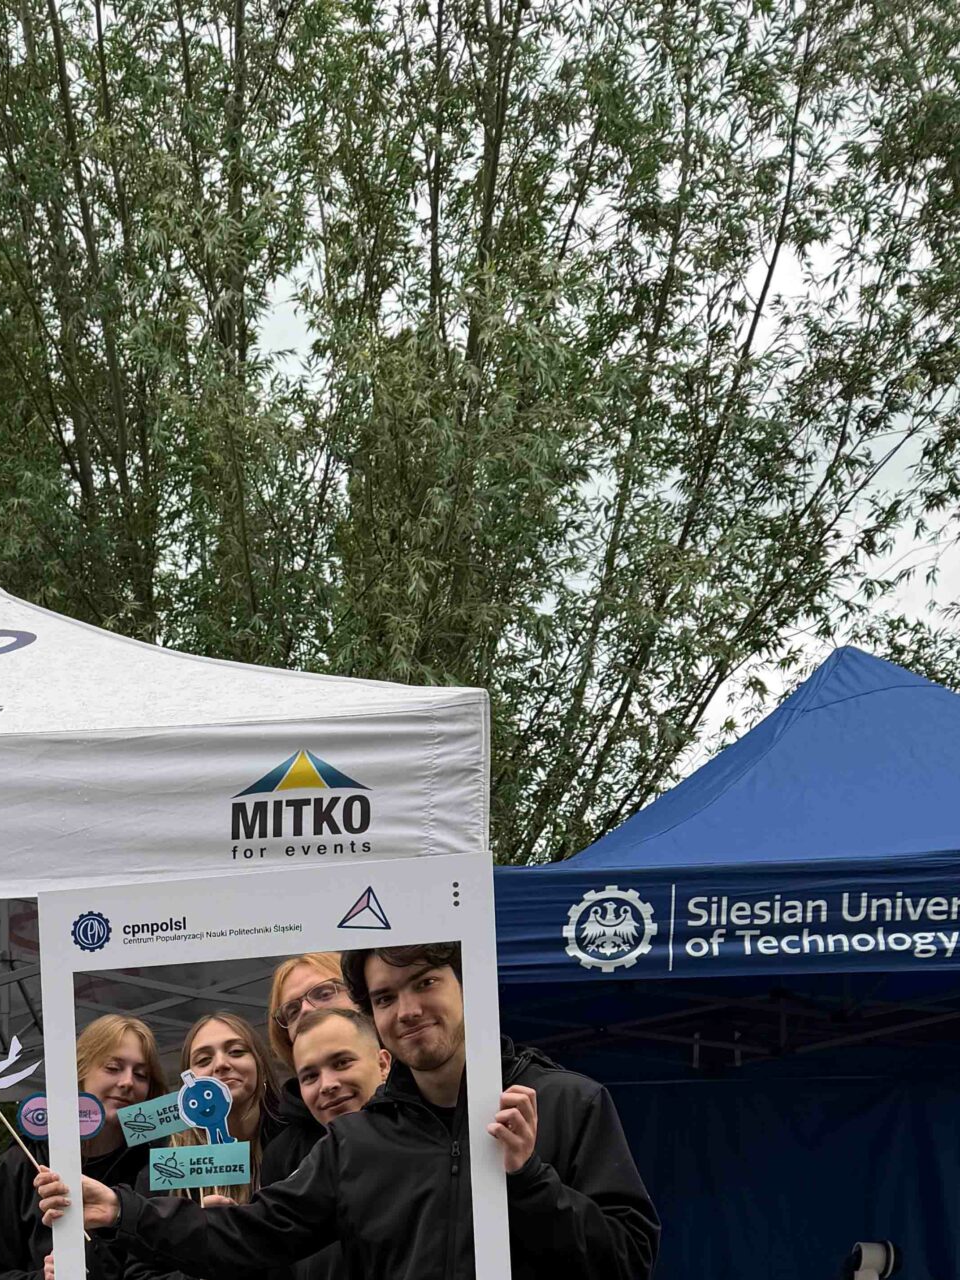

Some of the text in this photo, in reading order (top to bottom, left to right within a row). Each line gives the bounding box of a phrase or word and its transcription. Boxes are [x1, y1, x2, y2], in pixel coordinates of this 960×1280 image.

[230, 794, 371, 841] MITKO
[231, 840, 371, 859] for events
[687, 894, 828, 926] Silesian
[122, 916, 187, 938] cpnpolsl
[122, 923, 303, 945] Centrum Popularyzacji Nauki Politechniki Śląskiej
[685, 926, 960, 958] of Technology
[189, 1156, 215, 1166] LECĘ
[189, 1163, 245, 1176] PO WIEDZĘ
